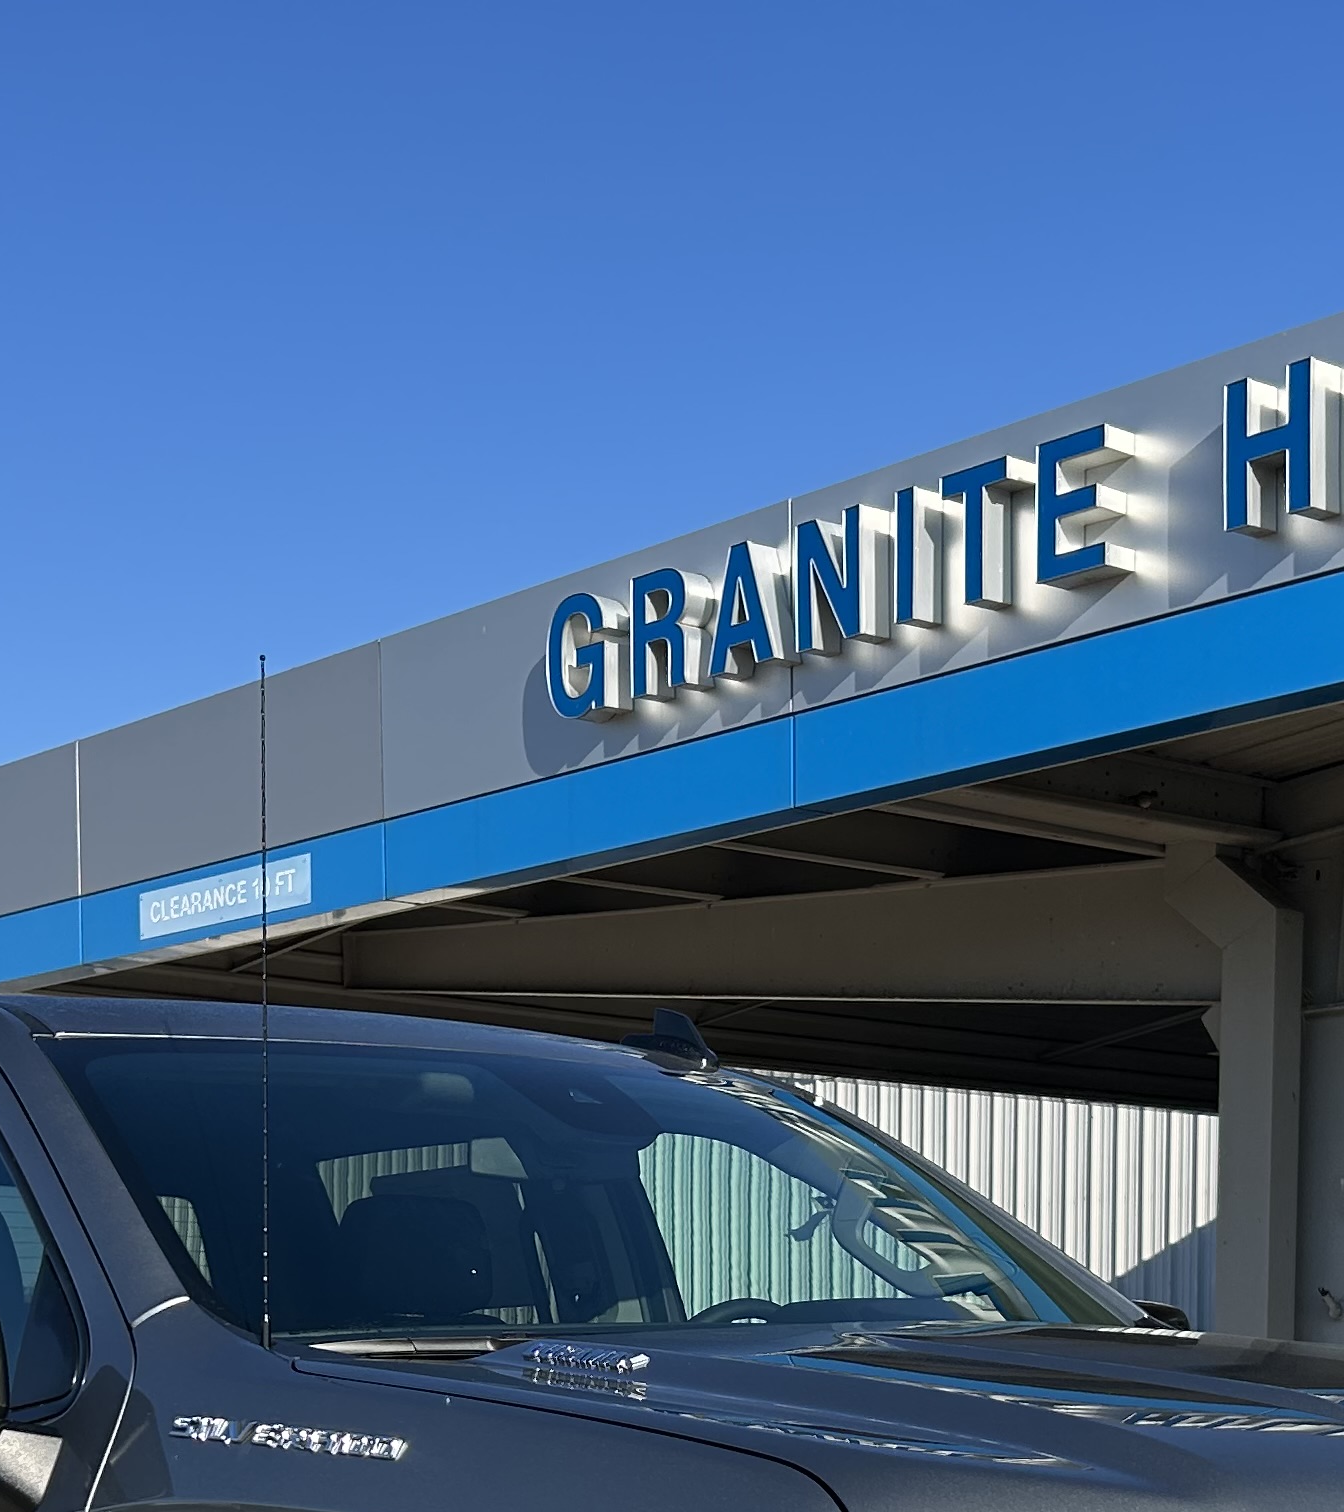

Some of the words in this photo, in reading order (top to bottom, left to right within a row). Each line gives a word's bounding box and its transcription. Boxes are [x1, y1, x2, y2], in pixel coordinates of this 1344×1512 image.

[546, 423, 1135, 722] GRANITE
[149, 880, 248, 923] CLEARANCE
[251, 876, 271, 900] 10
[274, 868, 297, 896] FT
